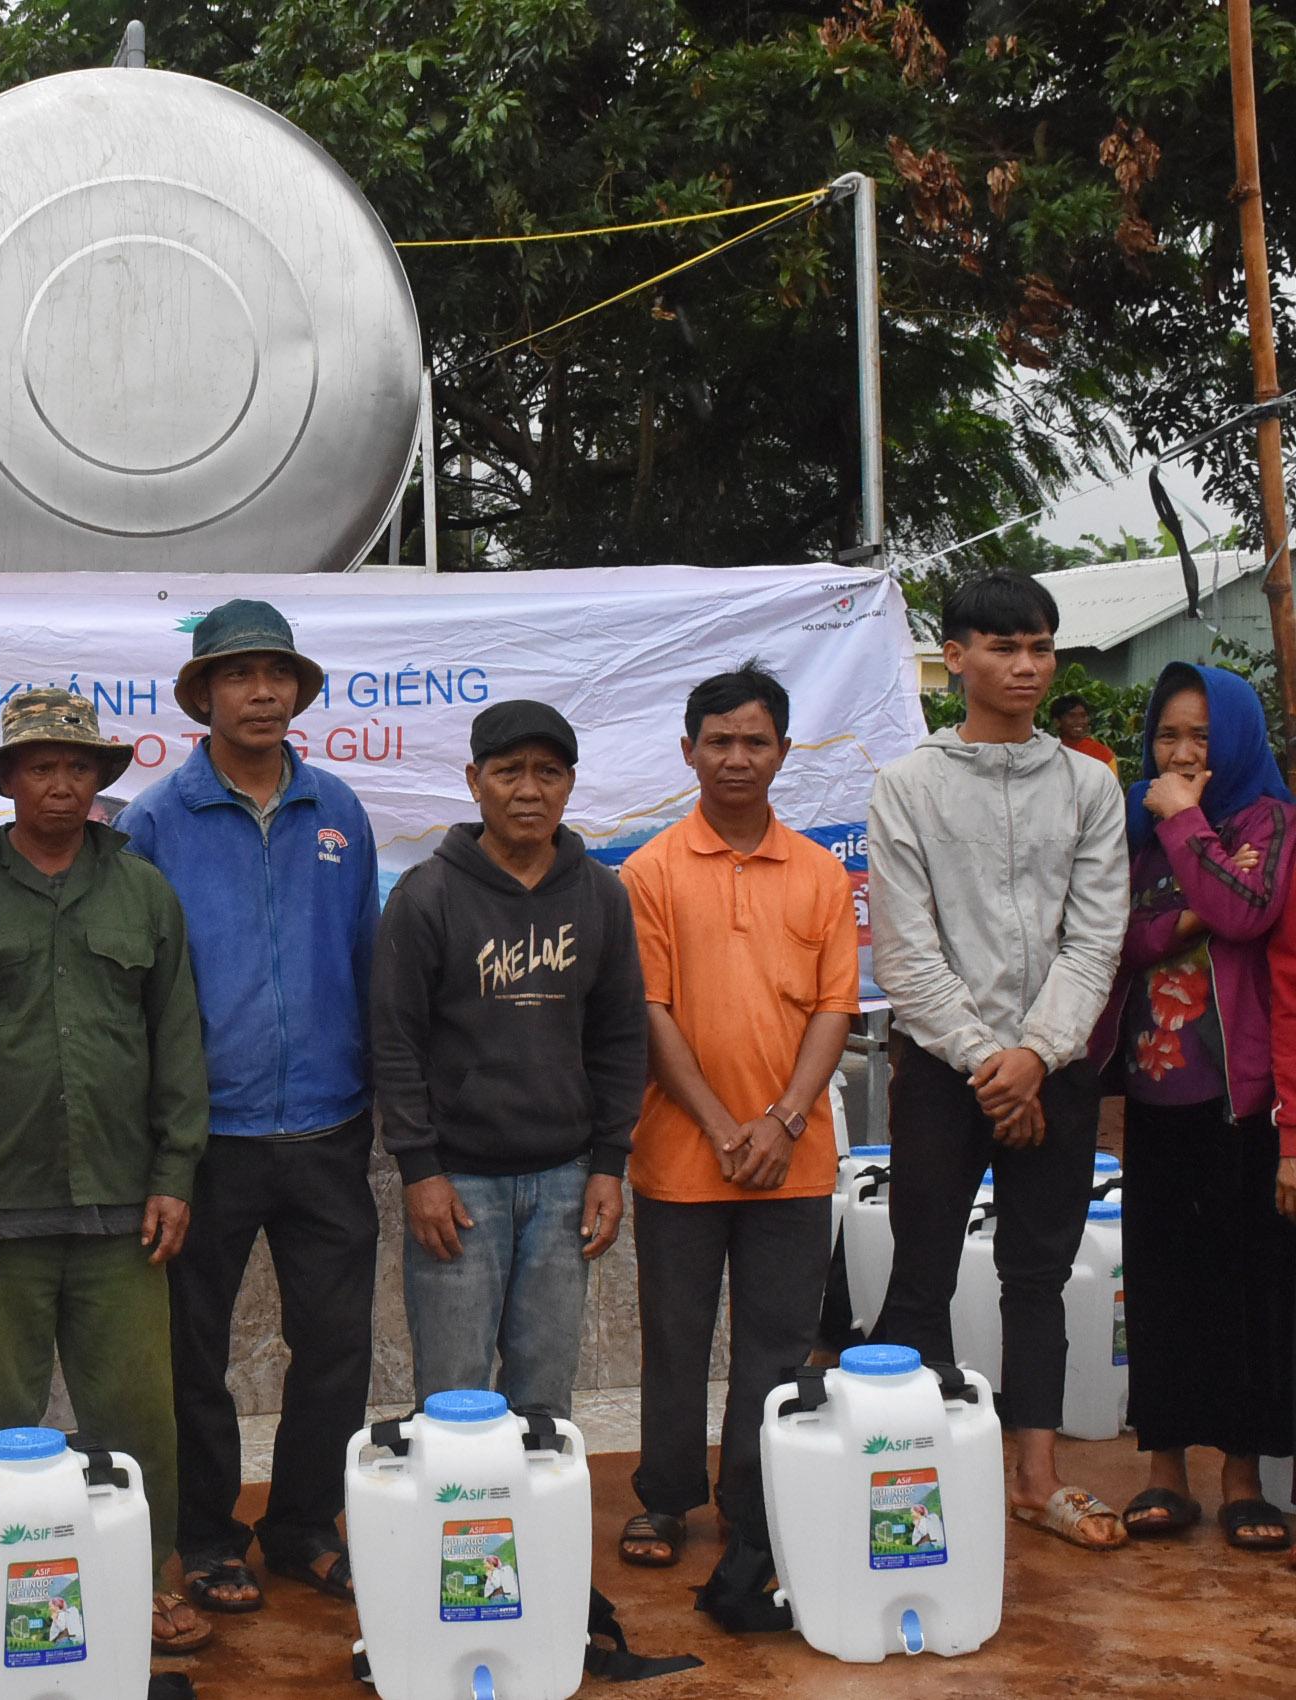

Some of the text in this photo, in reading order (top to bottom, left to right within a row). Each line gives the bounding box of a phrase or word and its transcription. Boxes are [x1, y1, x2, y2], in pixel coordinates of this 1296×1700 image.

[347, 662, 489, 708] GIẾNG
[181, 728, 308, 762] TG
[325, 718, 403, 762] GÙI
[476, 922, 577, 998] FAKE LOVE
[885, 1438, 913, 1452] ASIF
[459, 1488, 487, 1501] ASIF
[22, 1527, 52, 1544] ASIF
[34, 1567, 51, 1577] ASIF
